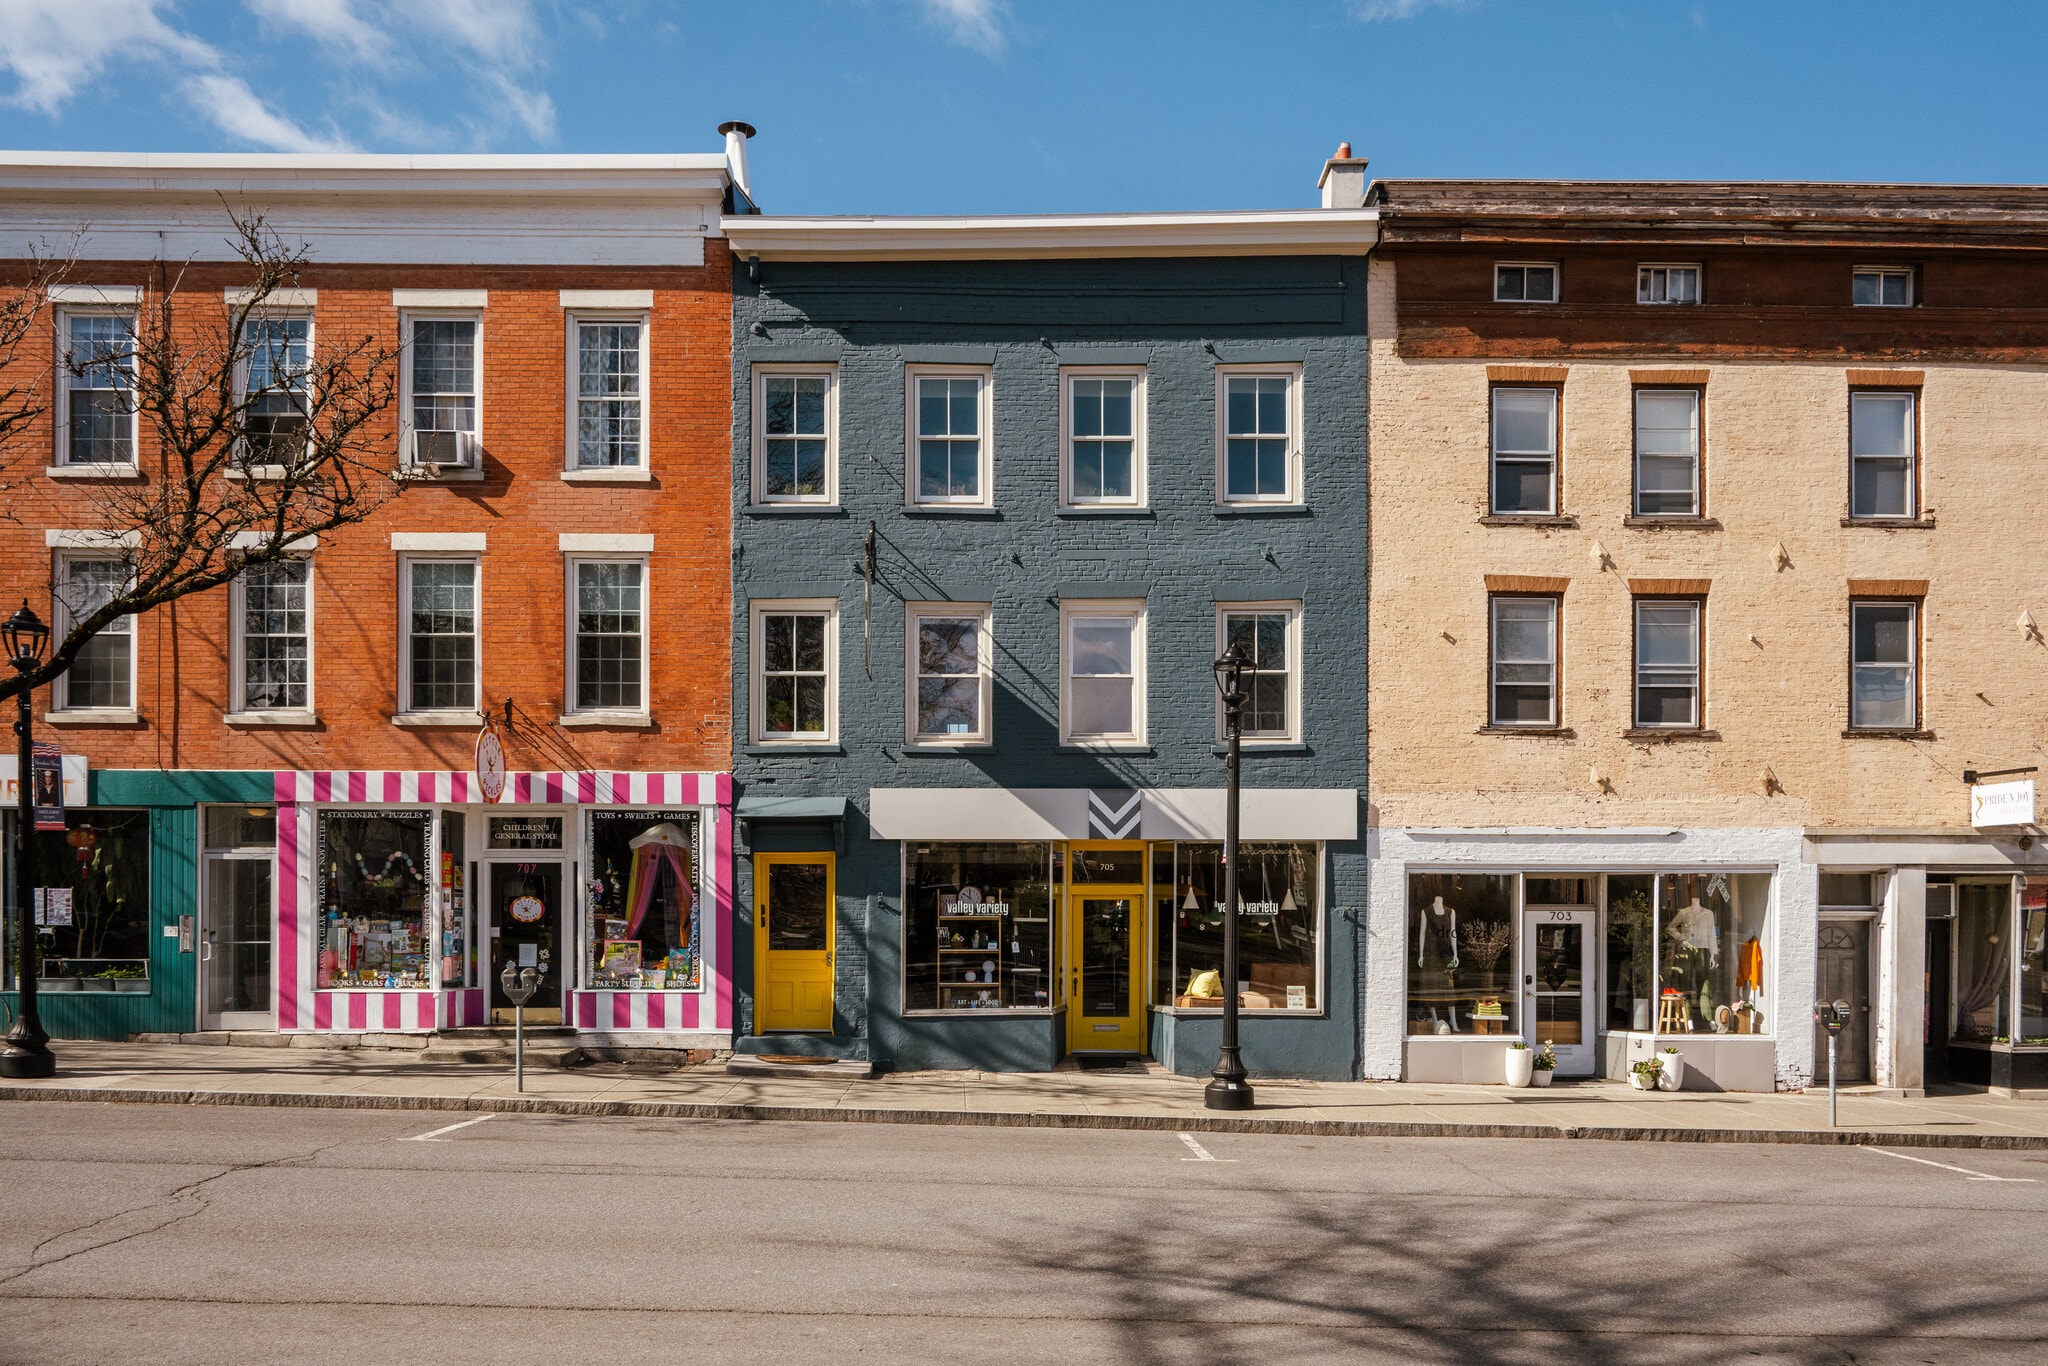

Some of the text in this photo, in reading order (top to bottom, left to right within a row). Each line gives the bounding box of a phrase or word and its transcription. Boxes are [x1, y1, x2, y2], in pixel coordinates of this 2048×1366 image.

[483, 736, 500, 755] LITTLE
[483, 778, 501, 795] PICKLES
[1985, 793, 2008, 805] PRIDE
[2016, 791, 2030, 803] JOY
[517, 863, 537, 874] 707
[1100, 863, 1114, 871] 705
[947, 900, 1009, 916] valley variety
[1217, 901, 1279, 915] vay variety
[1549, 911, 1572, 921] 703
